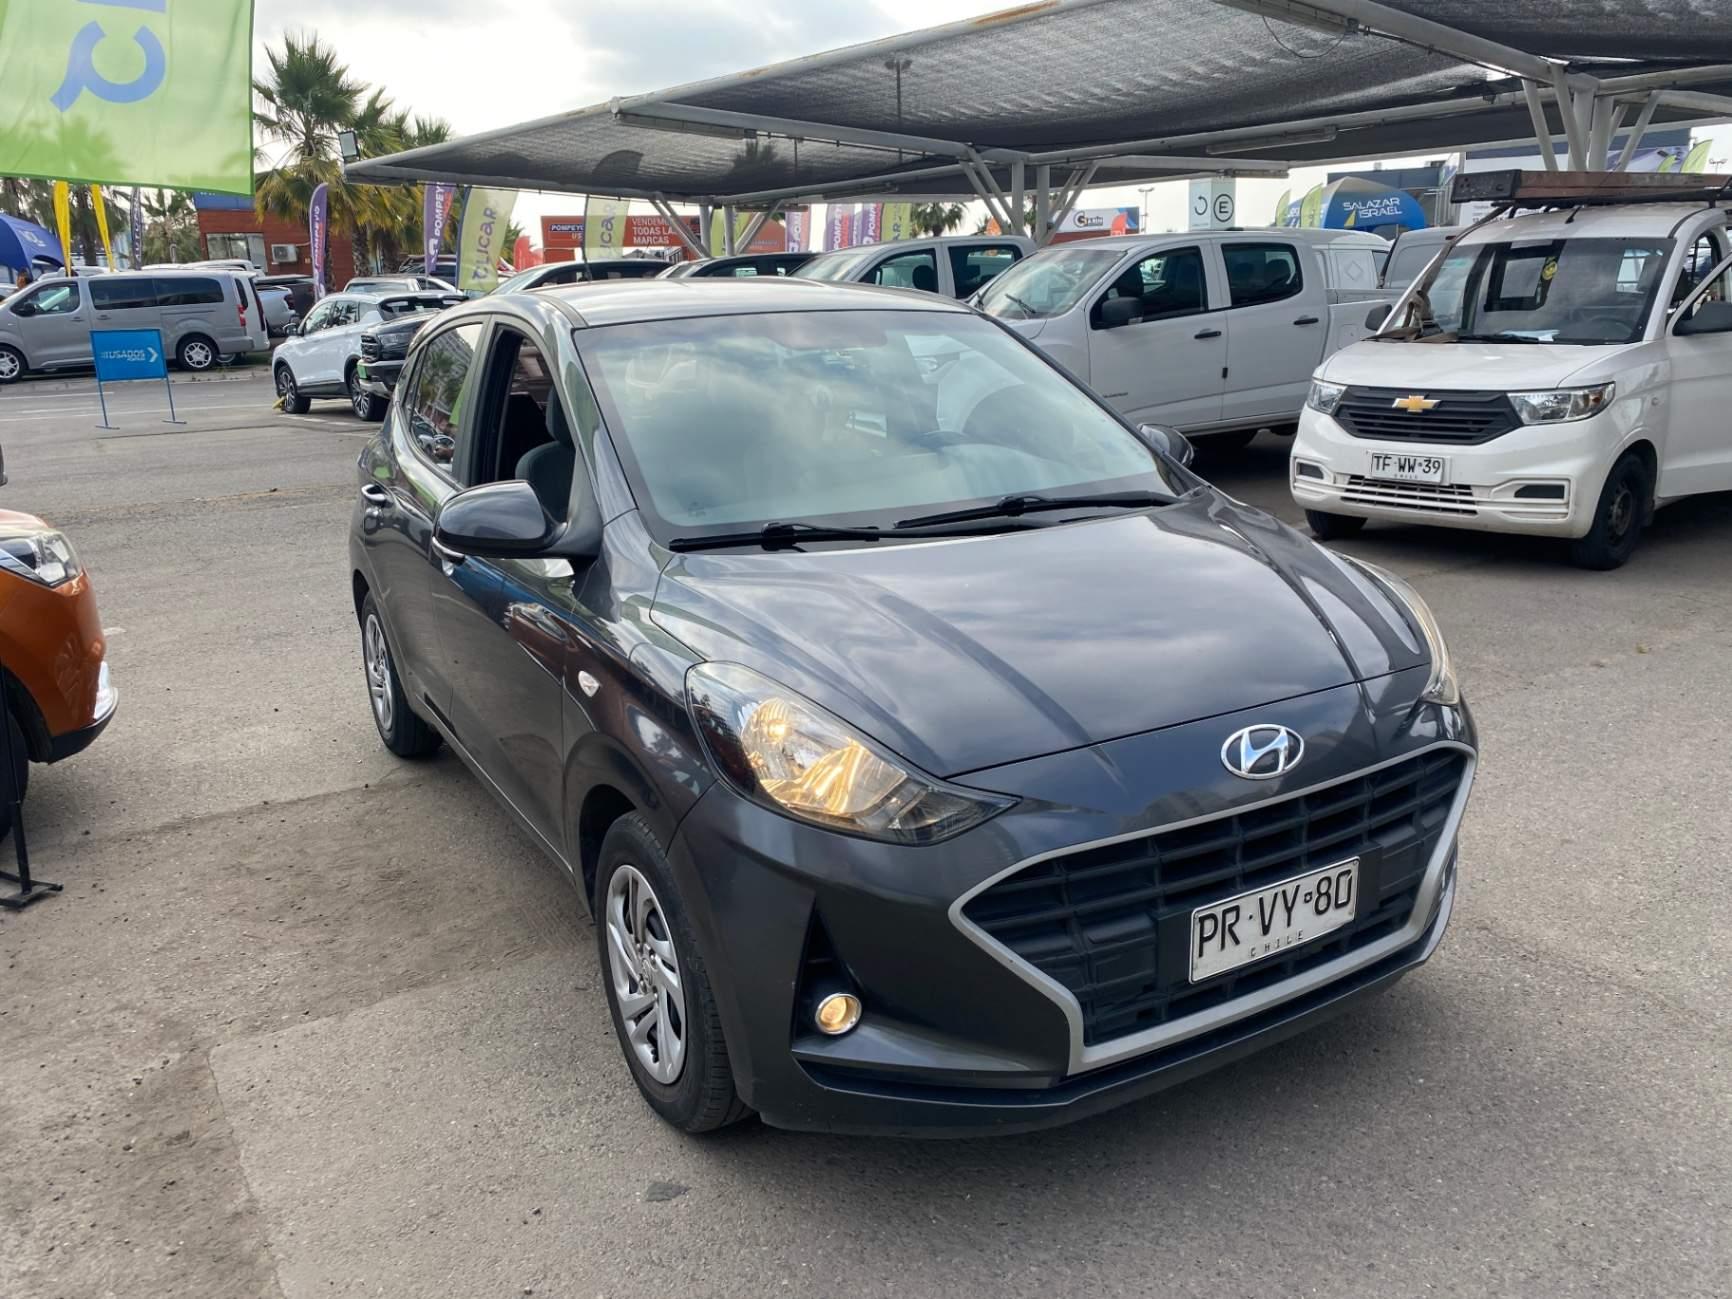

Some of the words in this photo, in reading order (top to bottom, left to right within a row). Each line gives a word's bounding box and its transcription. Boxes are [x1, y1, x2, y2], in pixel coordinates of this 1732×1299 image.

[1342, 197, 1401, 211] SALAZAR
[1359, 207, 1403, 218] ISRAEL
[632, 226, 661, 236] TODAS
[662, 226, 676, 236] LA
[633, 236, 670, 245] MARCAS
[1250, 930, 1304, 957] CHILE
